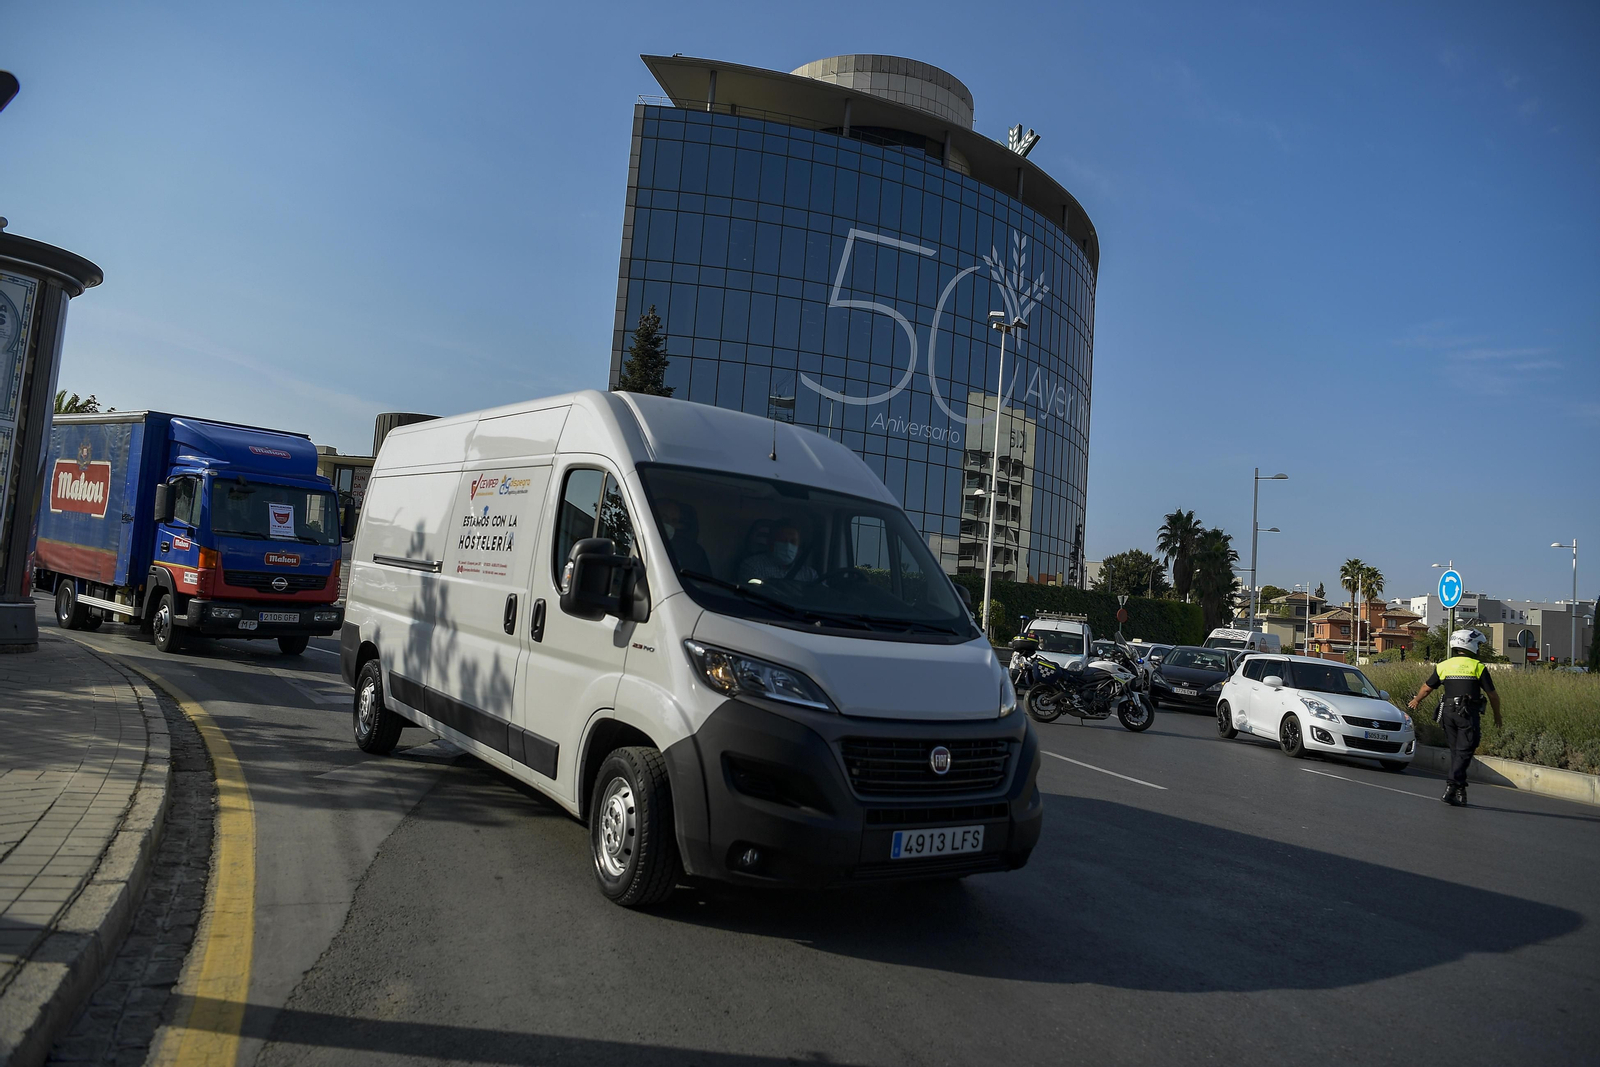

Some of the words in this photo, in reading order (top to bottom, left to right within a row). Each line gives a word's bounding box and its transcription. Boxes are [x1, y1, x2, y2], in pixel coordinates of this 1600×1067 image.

[800, 228, 1019, 425] 50
[871, 412, 960, 444] Aniversario
[57, 471, 104, 503] Mahou
[462, 515, 490, 527] ESTAMOS
[491, 515, 507, 527] CON
[508, 515, 518, 527] LA
[458, 531, 513, 551] HOSTELERÍA
[269, 555, 297, 563] Mahou
[935, 754, 947, 767] FIAT
[904, 832, 946, 855] 4913
[951, 830, 980, 852] LFS
